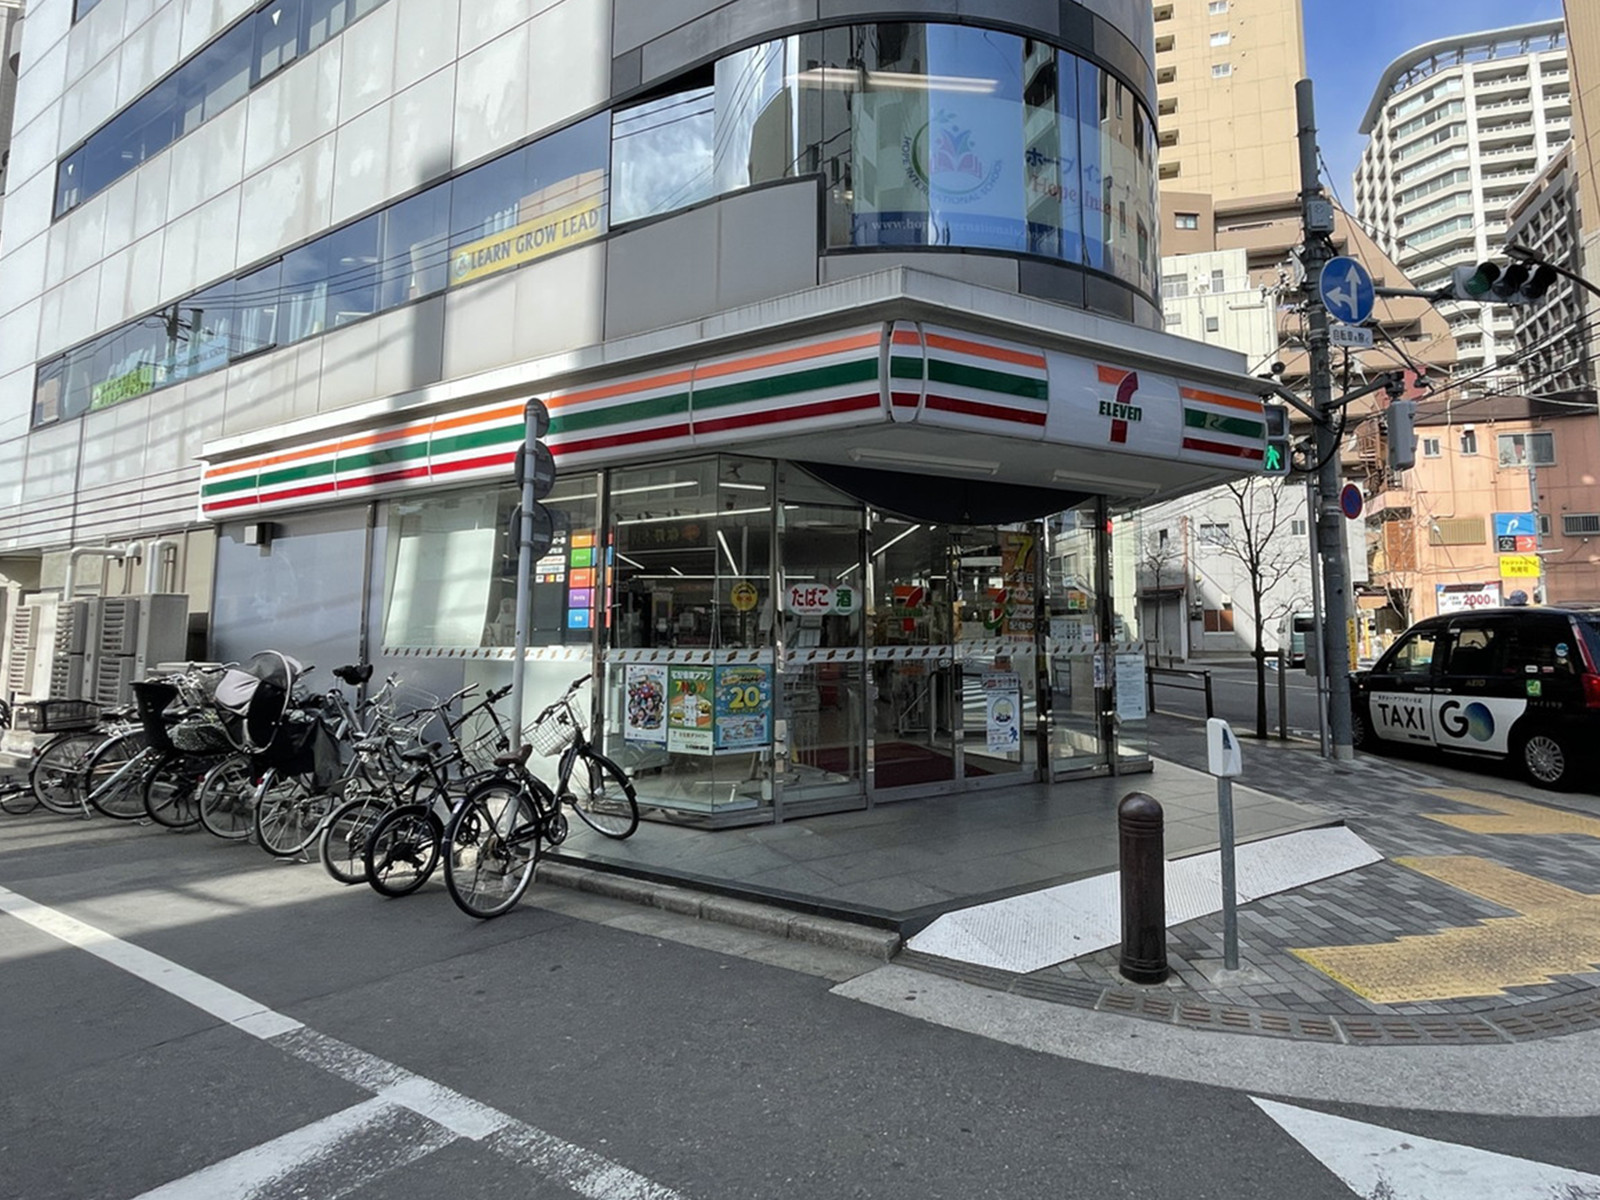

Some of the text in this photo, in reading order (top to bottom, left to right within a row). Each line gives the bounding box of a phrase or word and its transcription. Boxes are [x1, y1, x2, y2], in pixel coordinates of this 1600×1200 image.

[471, 210, 599, 270] LEARN GROW LEAD
[1096, 364, 1139, 444] 7
[791, 588, 829, 606] たばこ
[836, 589, 852, 607] 酒
[729, 686, 761, 709] 20
[1378, 703, 1425, 731] TAXI
